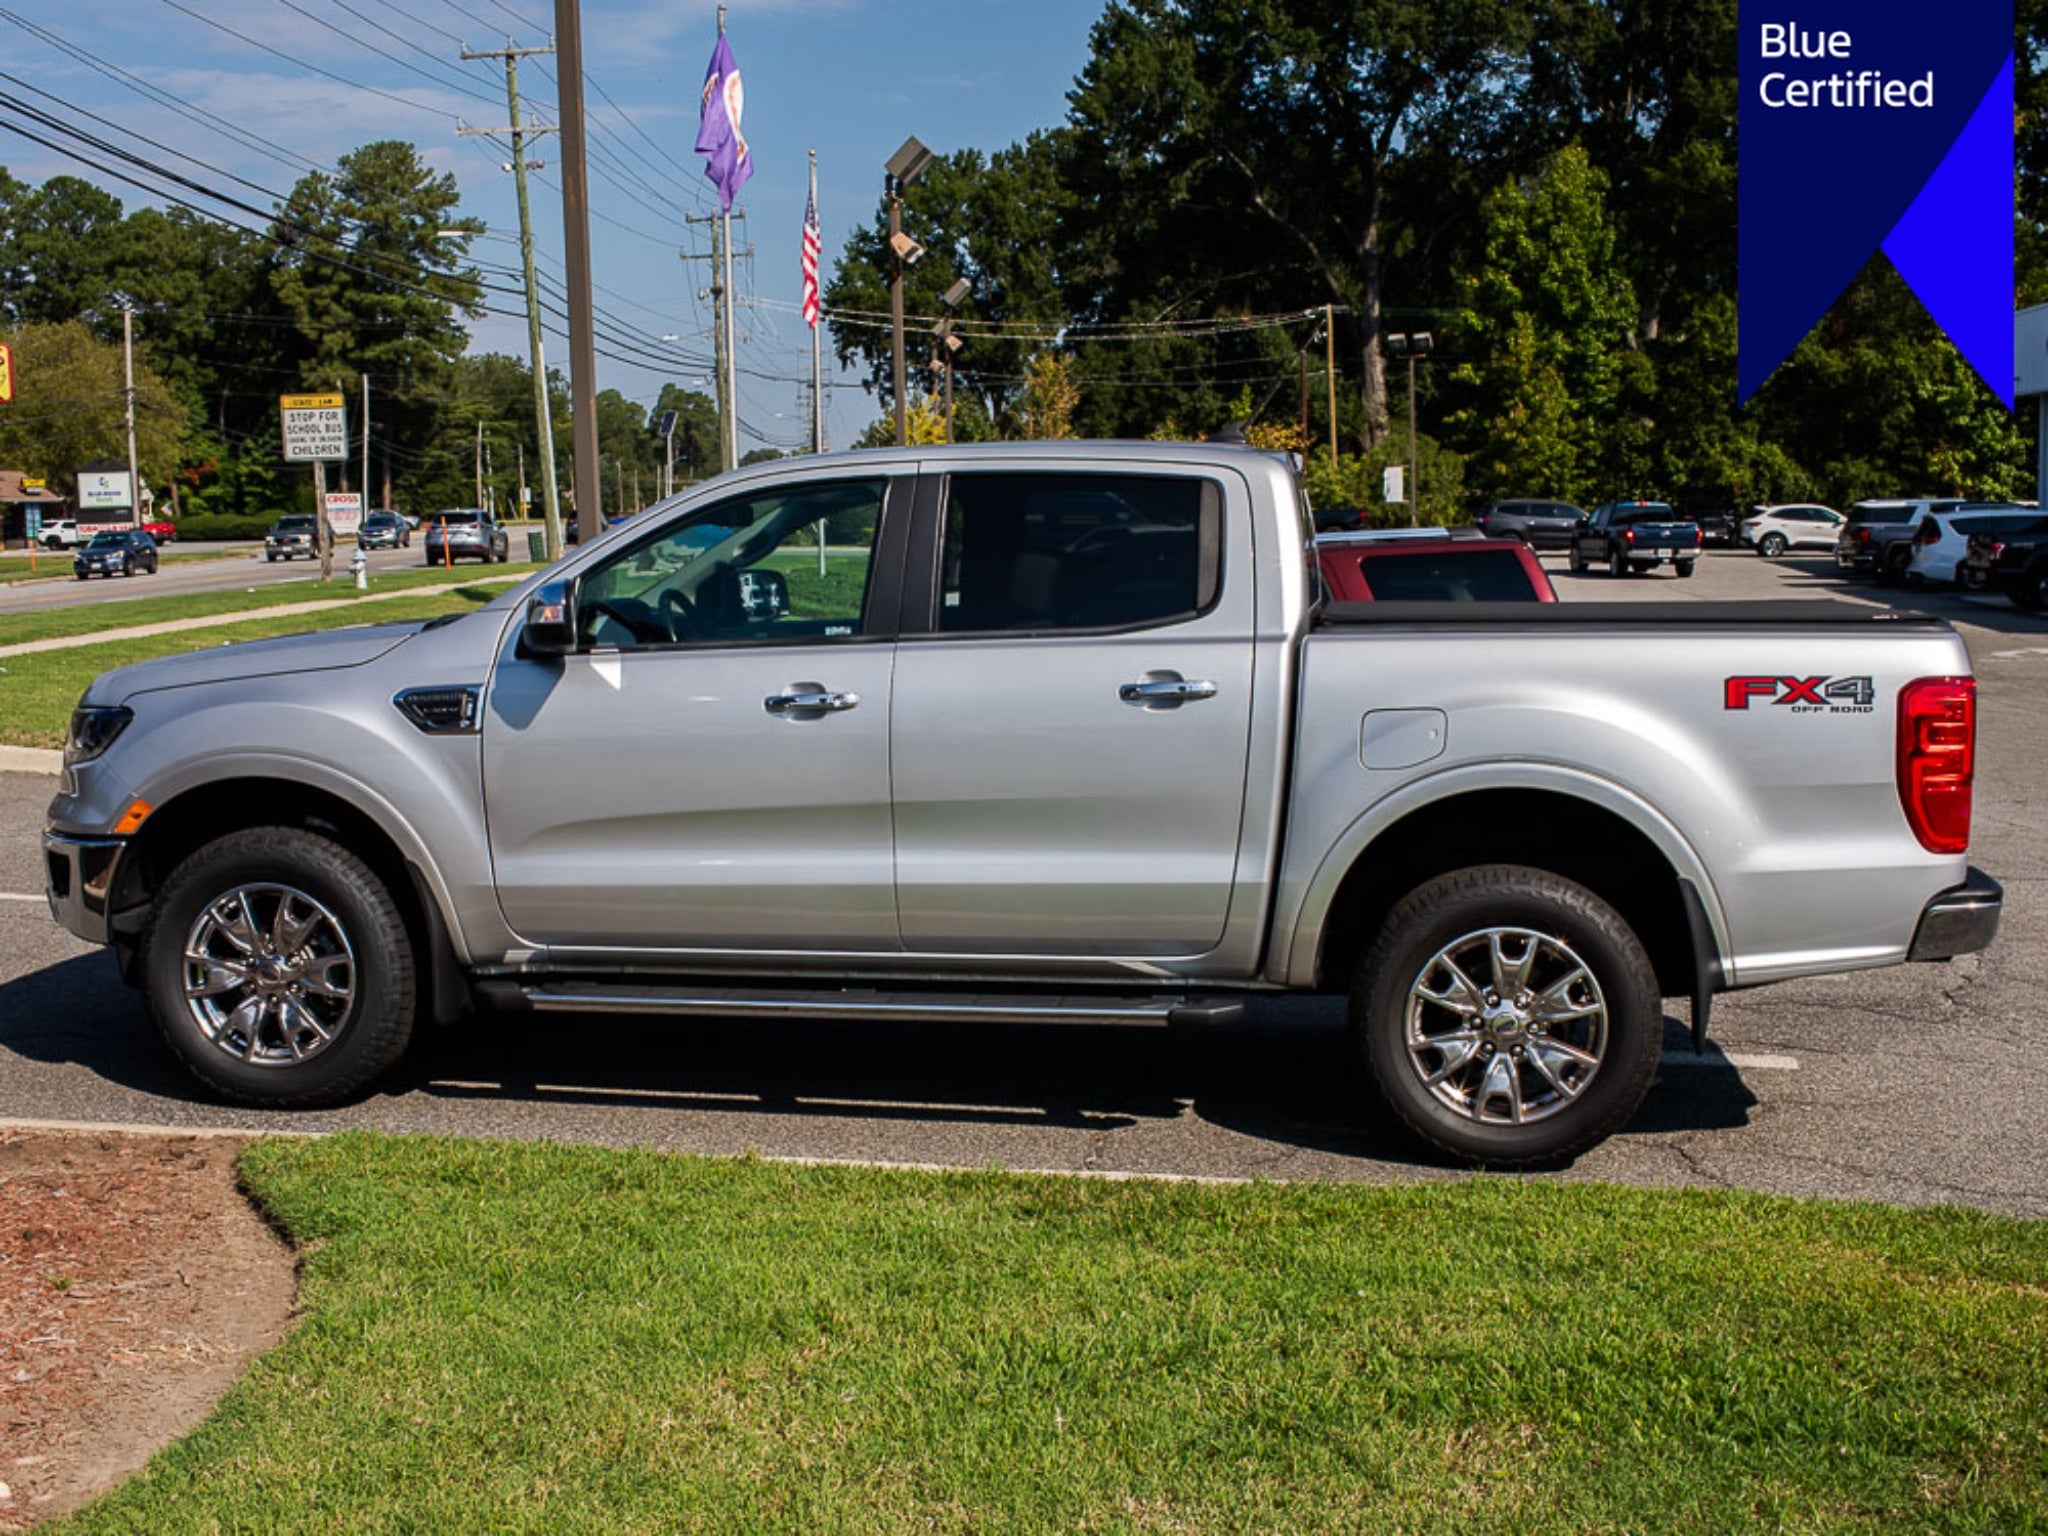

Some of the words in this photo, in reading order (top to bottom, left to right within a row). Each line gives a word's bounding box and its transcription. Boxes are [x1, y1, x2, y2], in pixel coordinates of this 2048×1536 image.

[290, 411, 316, 422] STOP
[319, 411, 339, 421] FOR
[287, 424, 322, 434] SCHOOL
[325, 423, 343, 433] BUS
[292, 445, 341, 455] CHILDREN
[1724, 675, 1875, 711] FX4
[1791, 706, 1824, 714] OFF
[1829, 706, 1875, 714] ROAD
